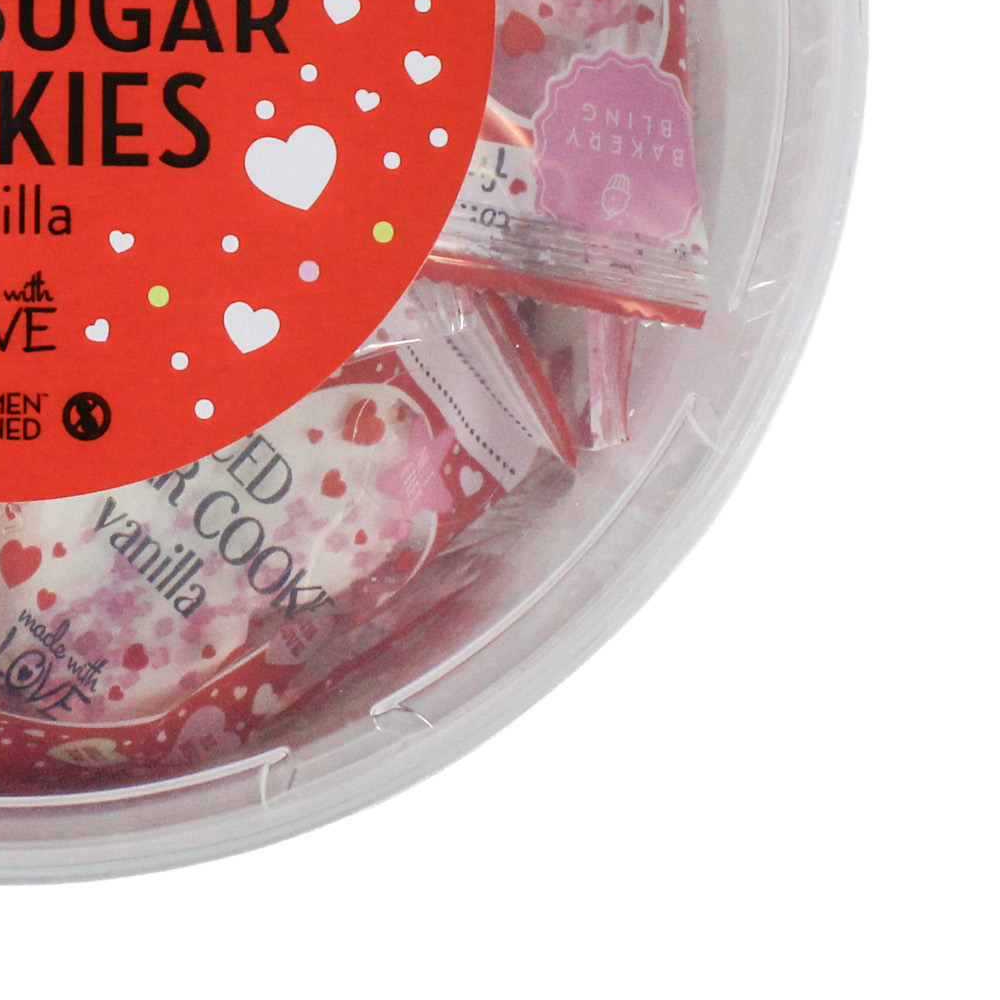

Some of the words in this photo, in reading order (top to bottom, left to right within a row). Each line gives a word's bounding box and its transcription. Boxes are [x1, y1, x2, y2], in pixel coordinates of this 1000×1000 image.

[565, 129, 685, 168] BAKERY
[582, 102, 673, 138] BLING
[4, 270, 54, 302] with
[93, 496, 208, 619] vanilla
[193, 490, 334, 620] COOK
[18, 610, 71, 660] made
[67, 657, 109, 692] with
